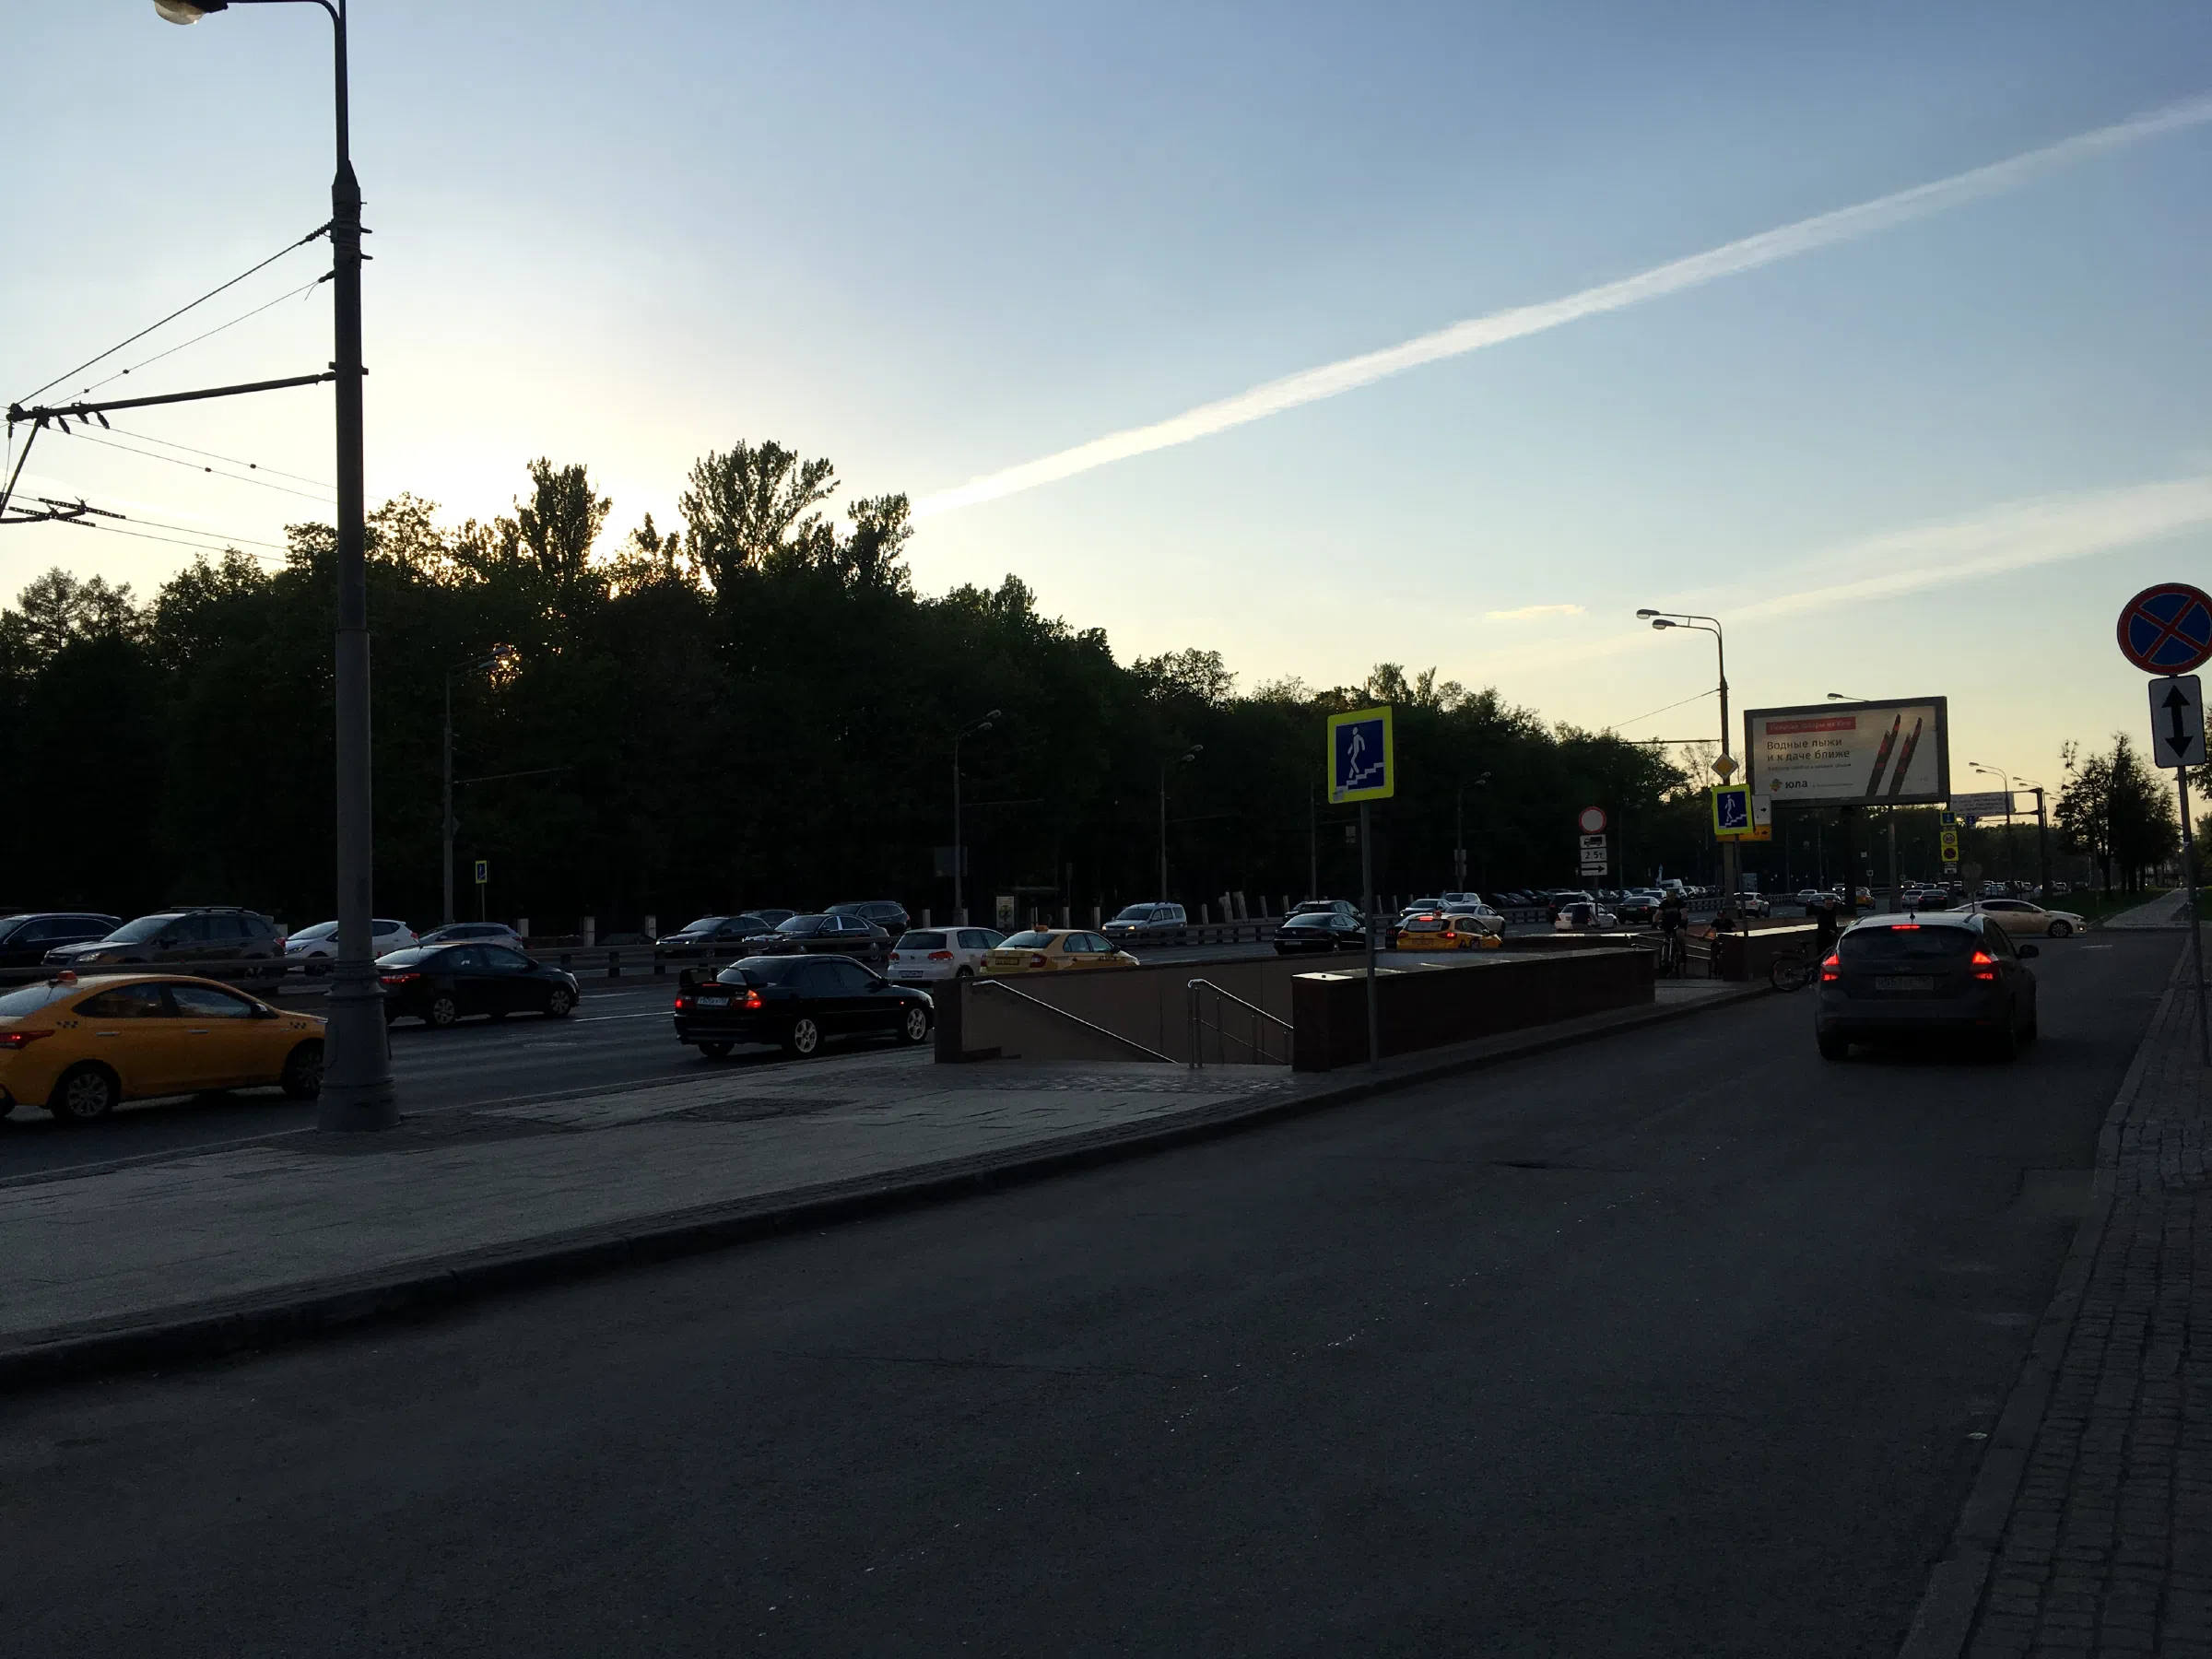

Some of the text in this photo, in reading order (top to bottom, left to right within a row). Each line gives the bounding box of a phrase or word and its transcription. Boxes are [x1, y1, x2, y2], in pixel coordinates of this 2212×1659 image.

[1767, 738, 1842, 750] Водные лыжи
[1777, 753, 1783, 761] к
[1785, 752, 1811, 762] даче
[1814, 749, 1850, 759] ближе
[1785, 780, 1808, 789] юла
